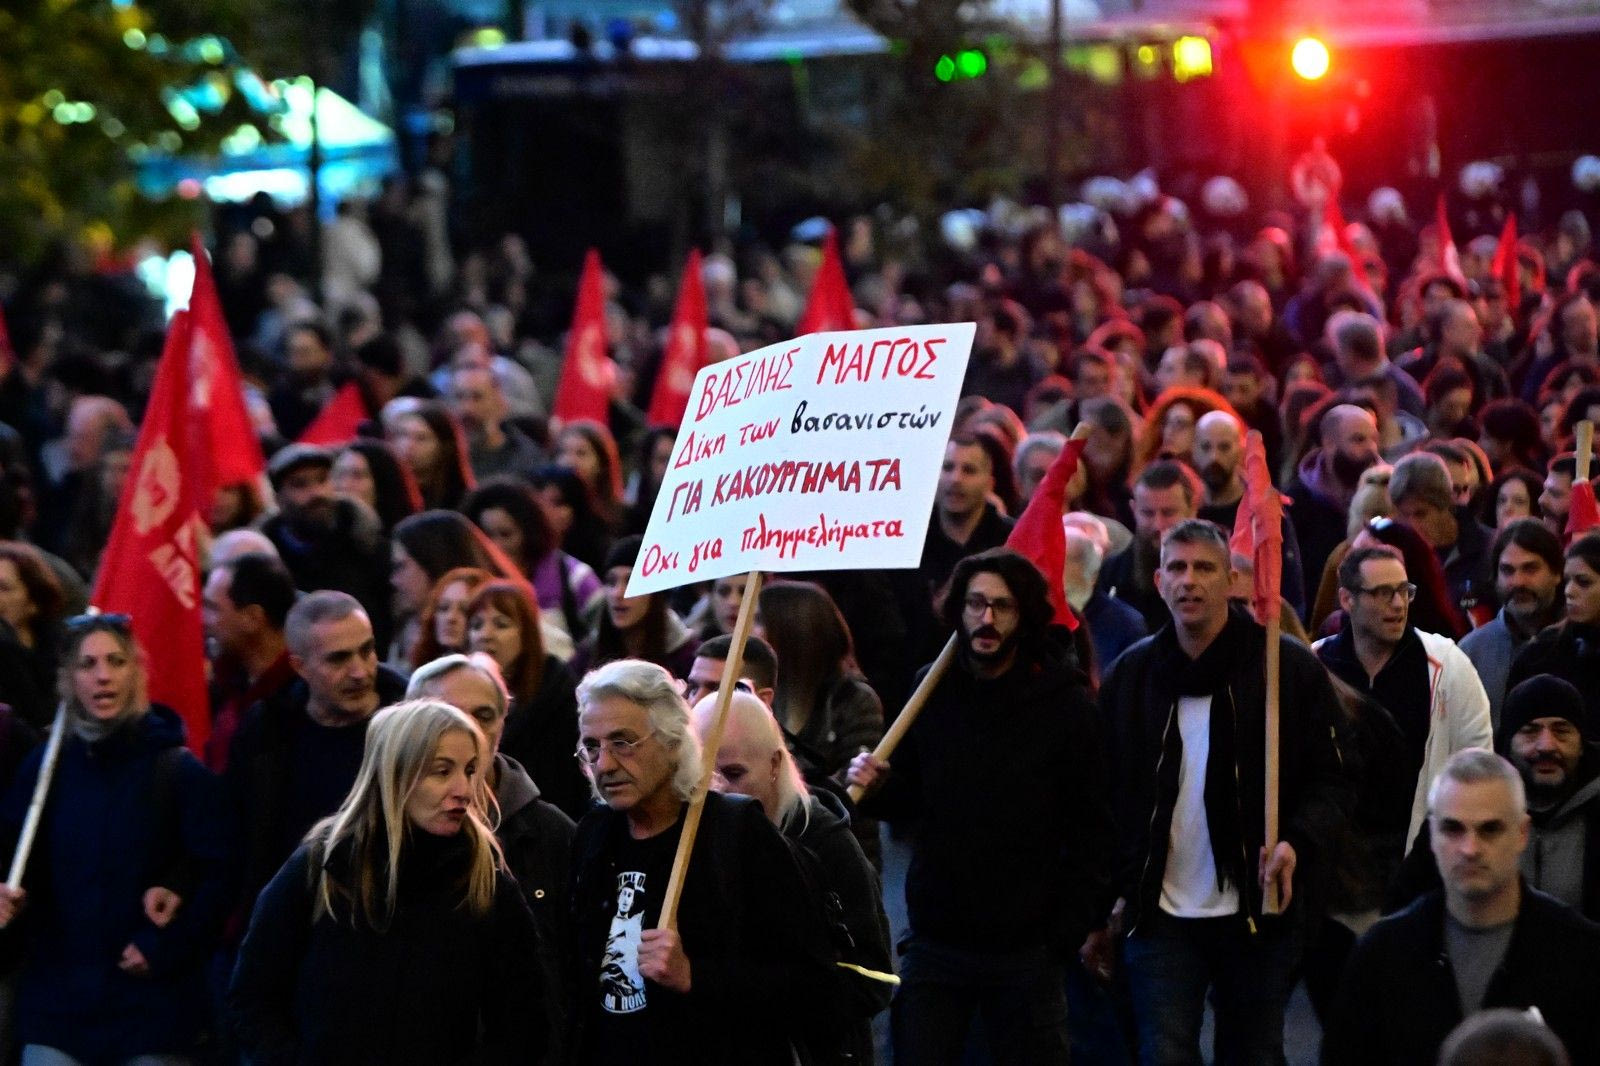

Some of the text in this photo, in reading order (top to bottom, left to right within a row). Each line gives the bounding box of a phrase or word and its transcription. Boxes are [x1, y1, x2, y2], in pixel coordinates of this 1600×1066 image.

[695, 338, 947, 422] ΒΑΣΙΛΗΣ ΜΑΓΓΟΣ
[674, 400, 941, 470] Δίκη των βασανιστών
[666, 458, 902, 523] ΓΙΑ ΚΑΚΟΥΡΓΗΜΑΤΑ
[688, 537, 722, 573] για
